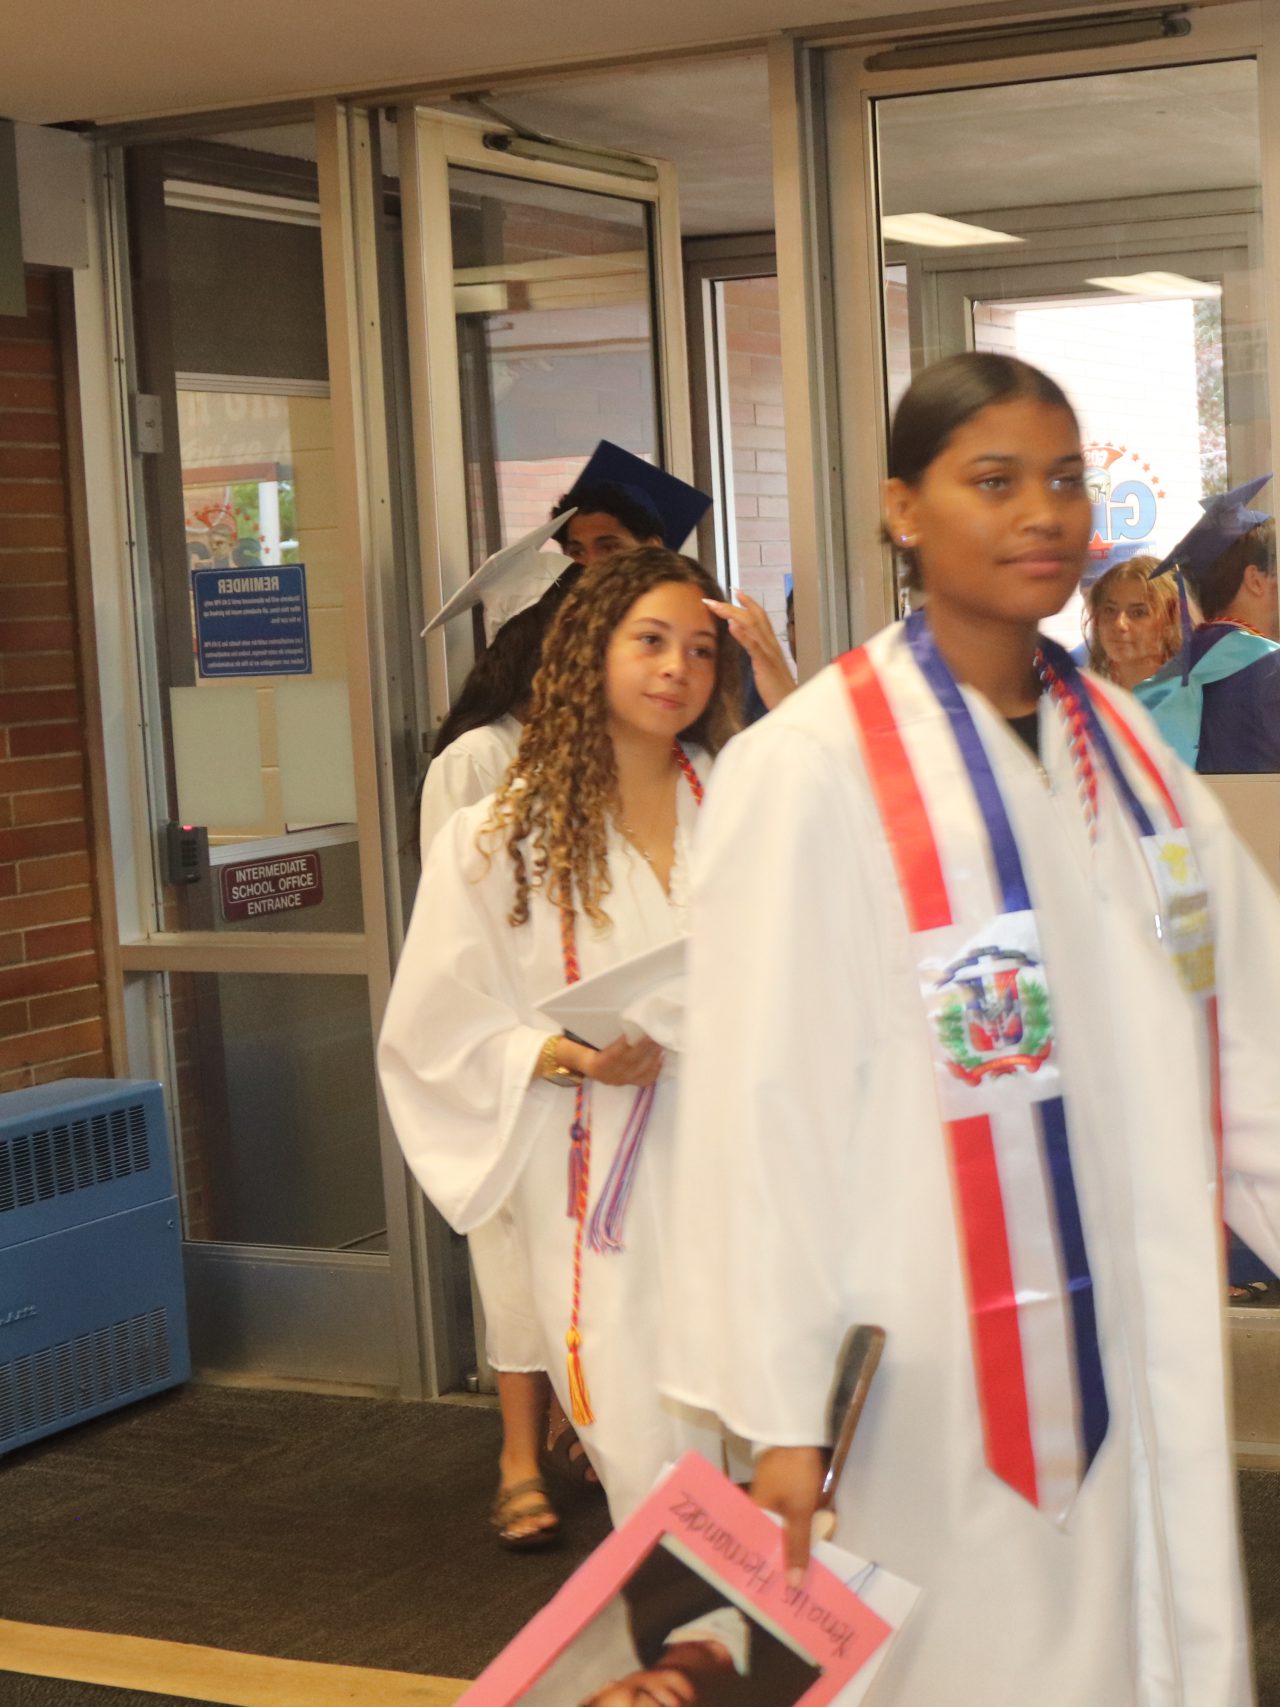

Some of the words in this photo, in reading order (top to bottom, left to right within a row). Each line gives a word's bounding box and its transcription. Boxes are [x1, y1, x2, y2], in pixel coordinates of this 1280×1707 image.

[236, 859, 307, 882] INTERMEDIATE
[231, 881, 275, 900] SCHOOL
[278, 873, 314, 890] OFFICE
[247, 894, 302, 915] ENTRANCE
